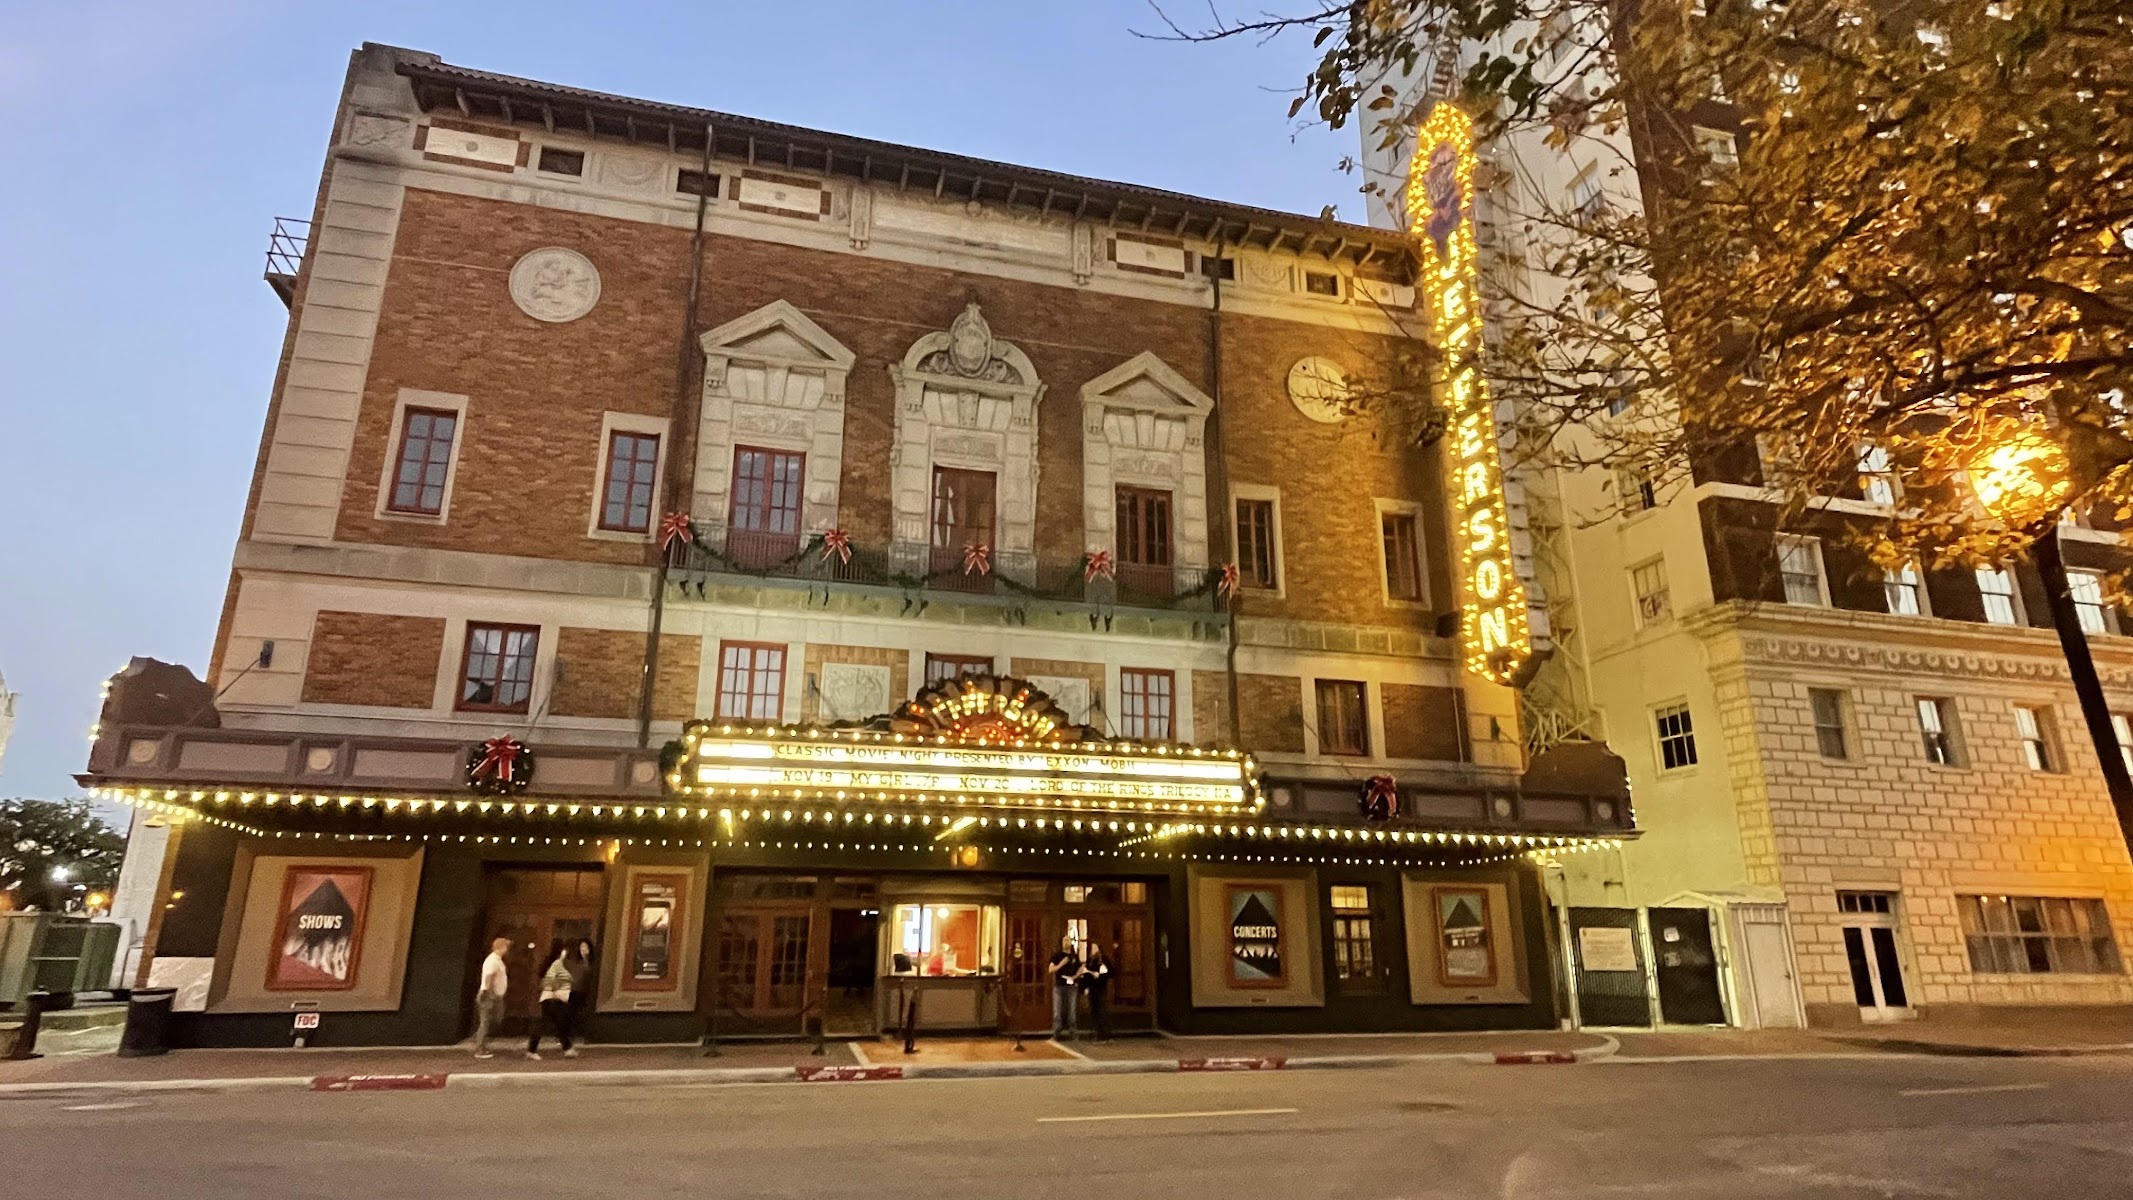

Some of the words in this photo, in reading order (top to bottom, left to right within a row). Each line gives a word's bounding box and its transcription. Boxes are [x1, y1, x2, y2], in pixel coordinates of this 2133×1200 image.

[1440, 230, 1508, 654] JEFFERSON
[777, 744, 834, 758] CLASSIC
[845, 748, 892, 761] MOVIE
[900, 750, 937, 762] NIGHT
[944, 752, 1013, 765] PRESENTED
[1018, 755, 1036, 766] BY
[1046, 756, 1090, 768] EXXON
[783, 769, 813, 783] NOV
[820, 770, 832, 783] 19
[850, 772, 873, 786] MY
[879, 774, 912, 787] GIRL
[960, 777, 989, 789] NOV
[1030, 780, 1064, 791] LORD
[1070, 781, 1085, 793] OF
[1091, 782, 1114, 794] THE
[1119, 784, 1155, 796] RINGS
[1160, 785, 1209, 798] TRILOGY
[299, 914, 343, 930] SHOWS
[1233, 925, 1278, 939] CONCERTS
[296, 1015, 317, 1027] FDC
